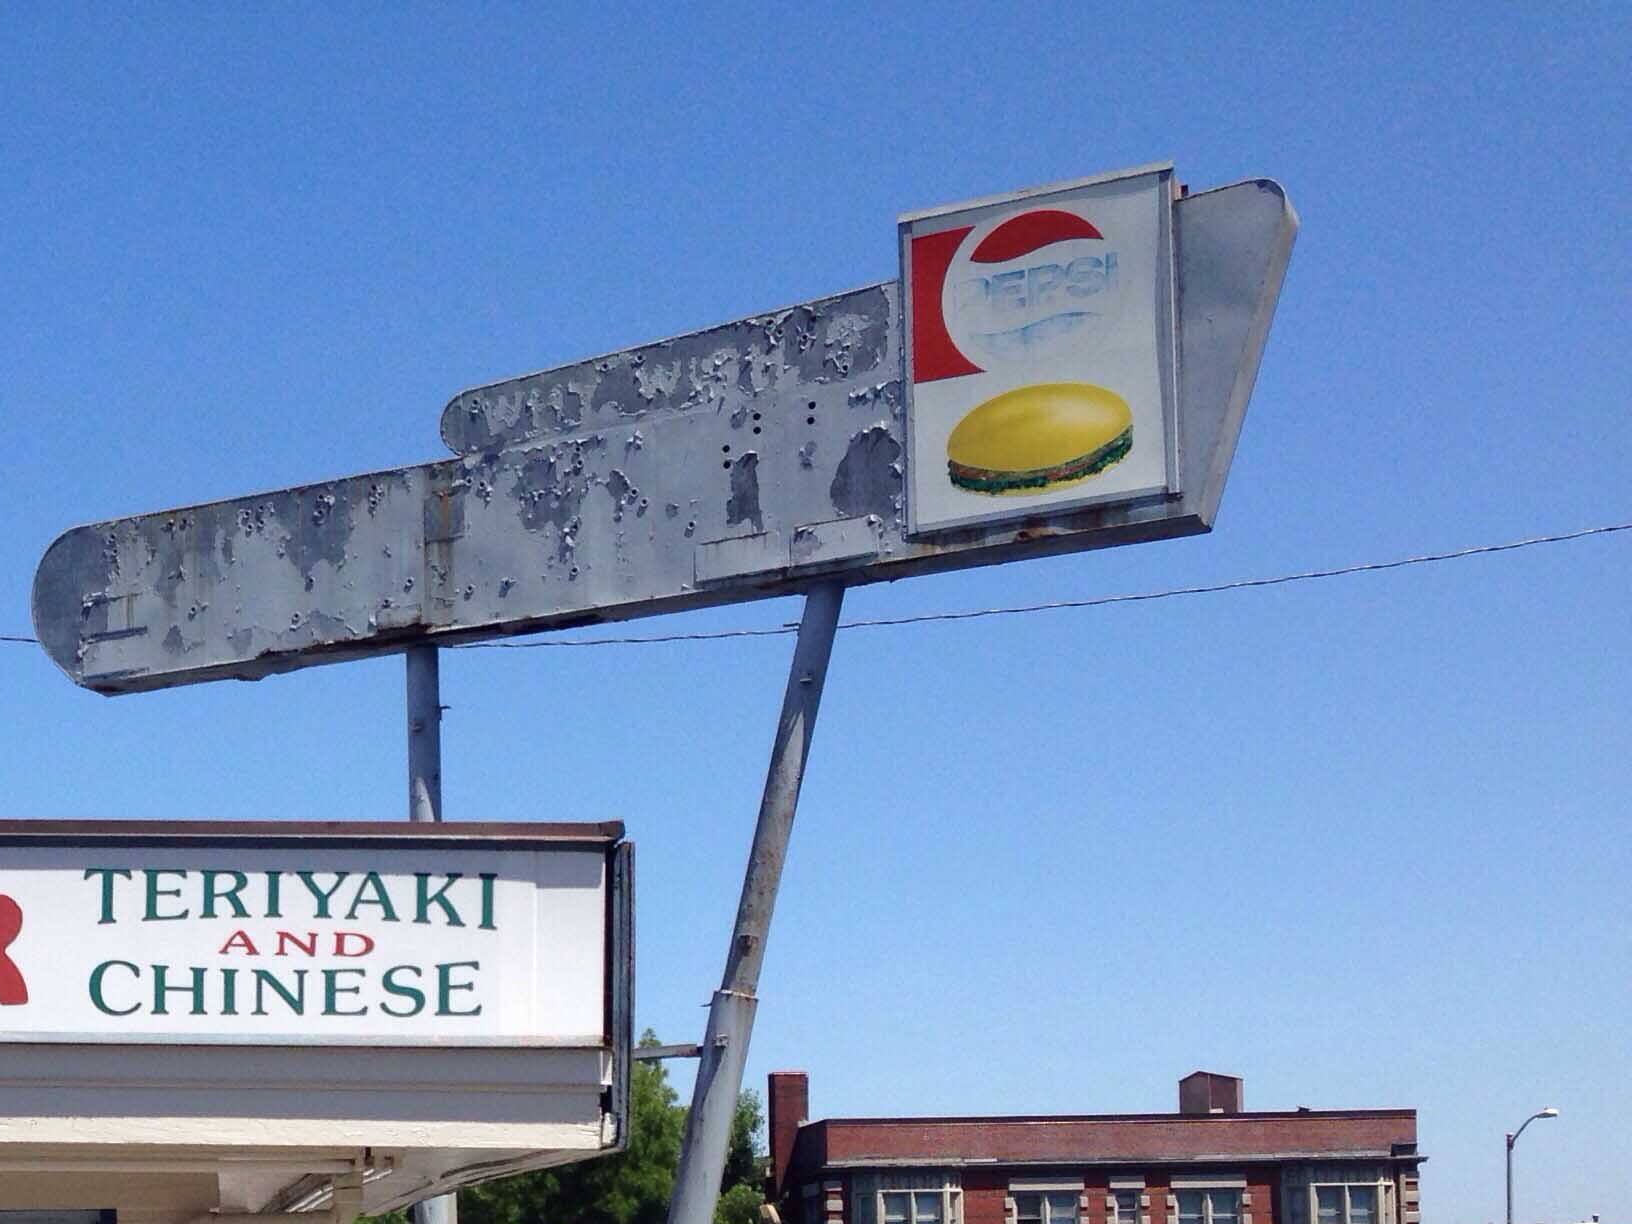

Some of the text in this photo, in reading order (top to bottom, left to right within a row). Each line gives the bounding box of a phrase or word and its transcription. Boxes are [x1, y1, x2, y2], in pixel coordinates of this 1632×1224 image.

[84, 867, 499, 929] TERIYAKI
[218, 929, 376, 957] AND
[88, 958, 484, 1018] CHINESE
